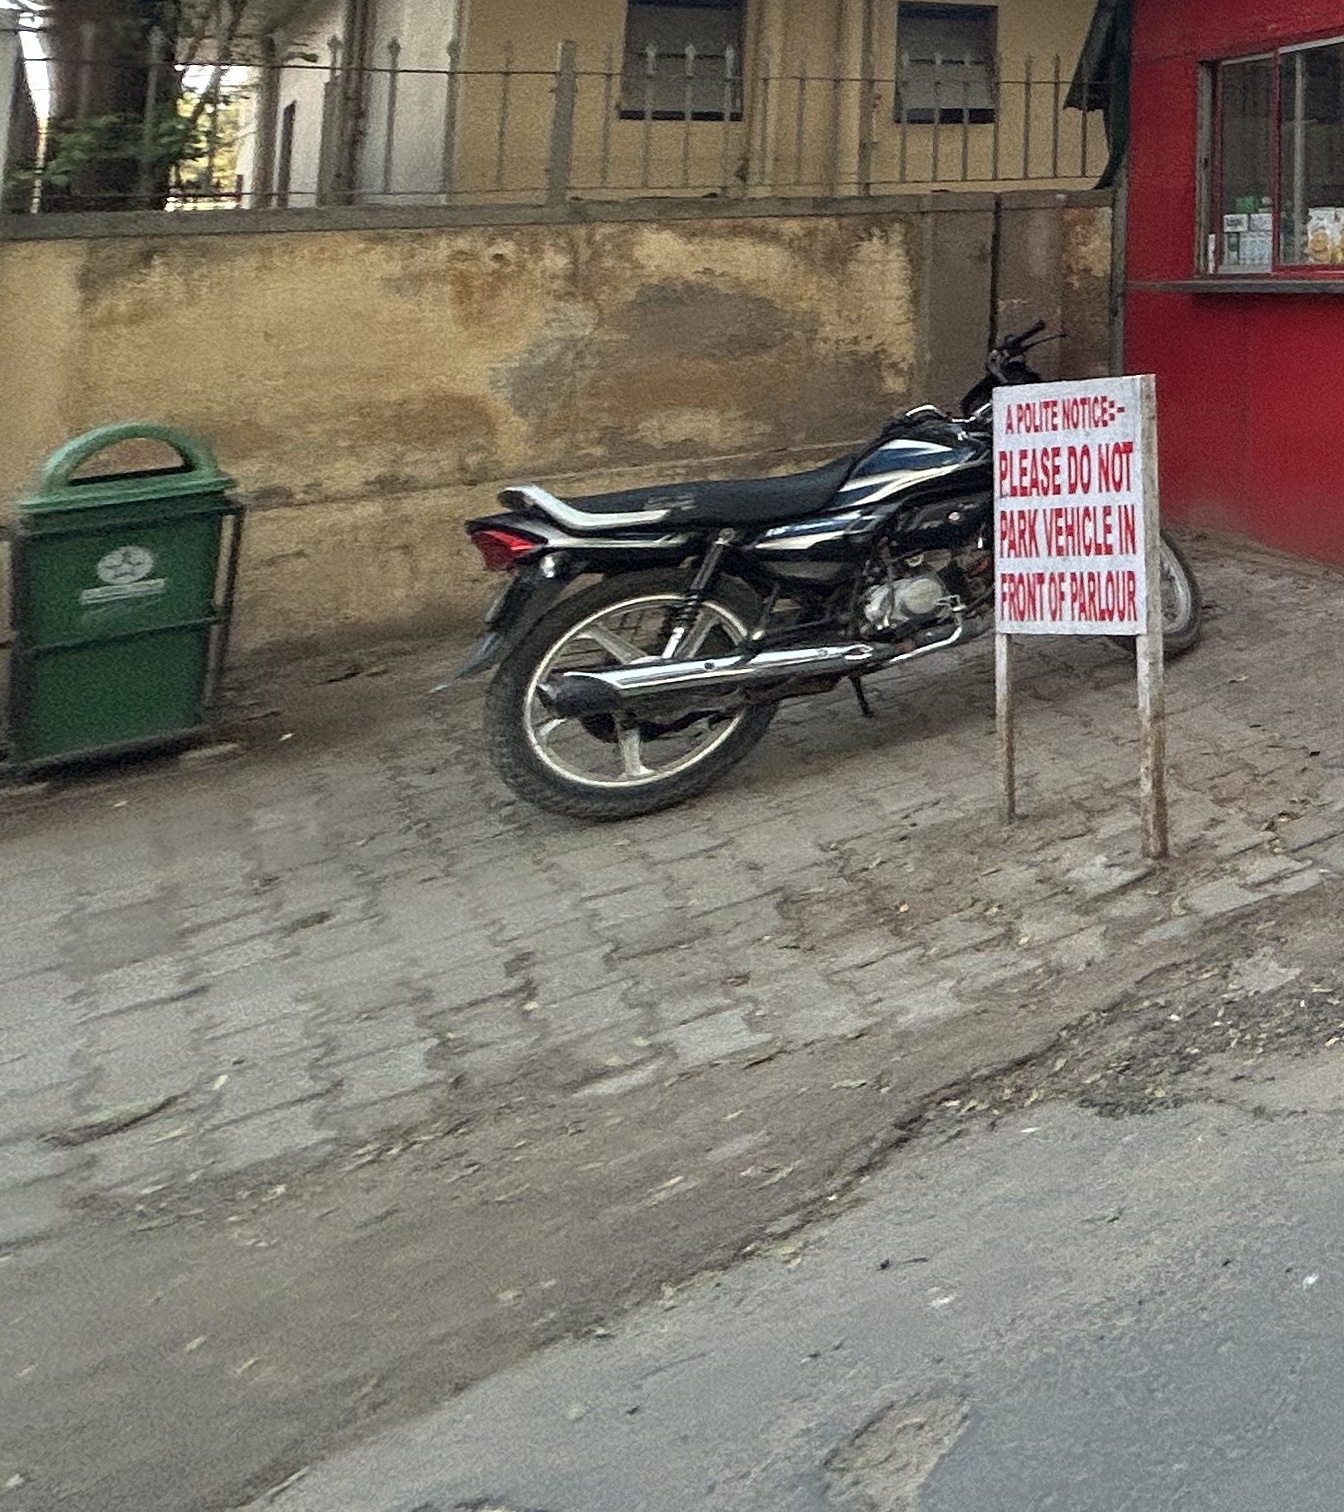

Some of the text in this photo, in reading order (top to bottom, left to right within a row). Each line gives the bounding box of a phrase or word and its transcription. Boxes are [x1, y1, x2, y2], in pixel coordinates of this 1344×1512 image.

[1005, 404, 1013, 434] A
[1016, 400, 1059, 434] POLITE
[999, 441, 1134, 498] PLEASE DO NOT
[1000, 504, 1137, 559] PARK VEHICLE IN
[1001, 570, 1138, 622] FRONT OF PARLOUR
